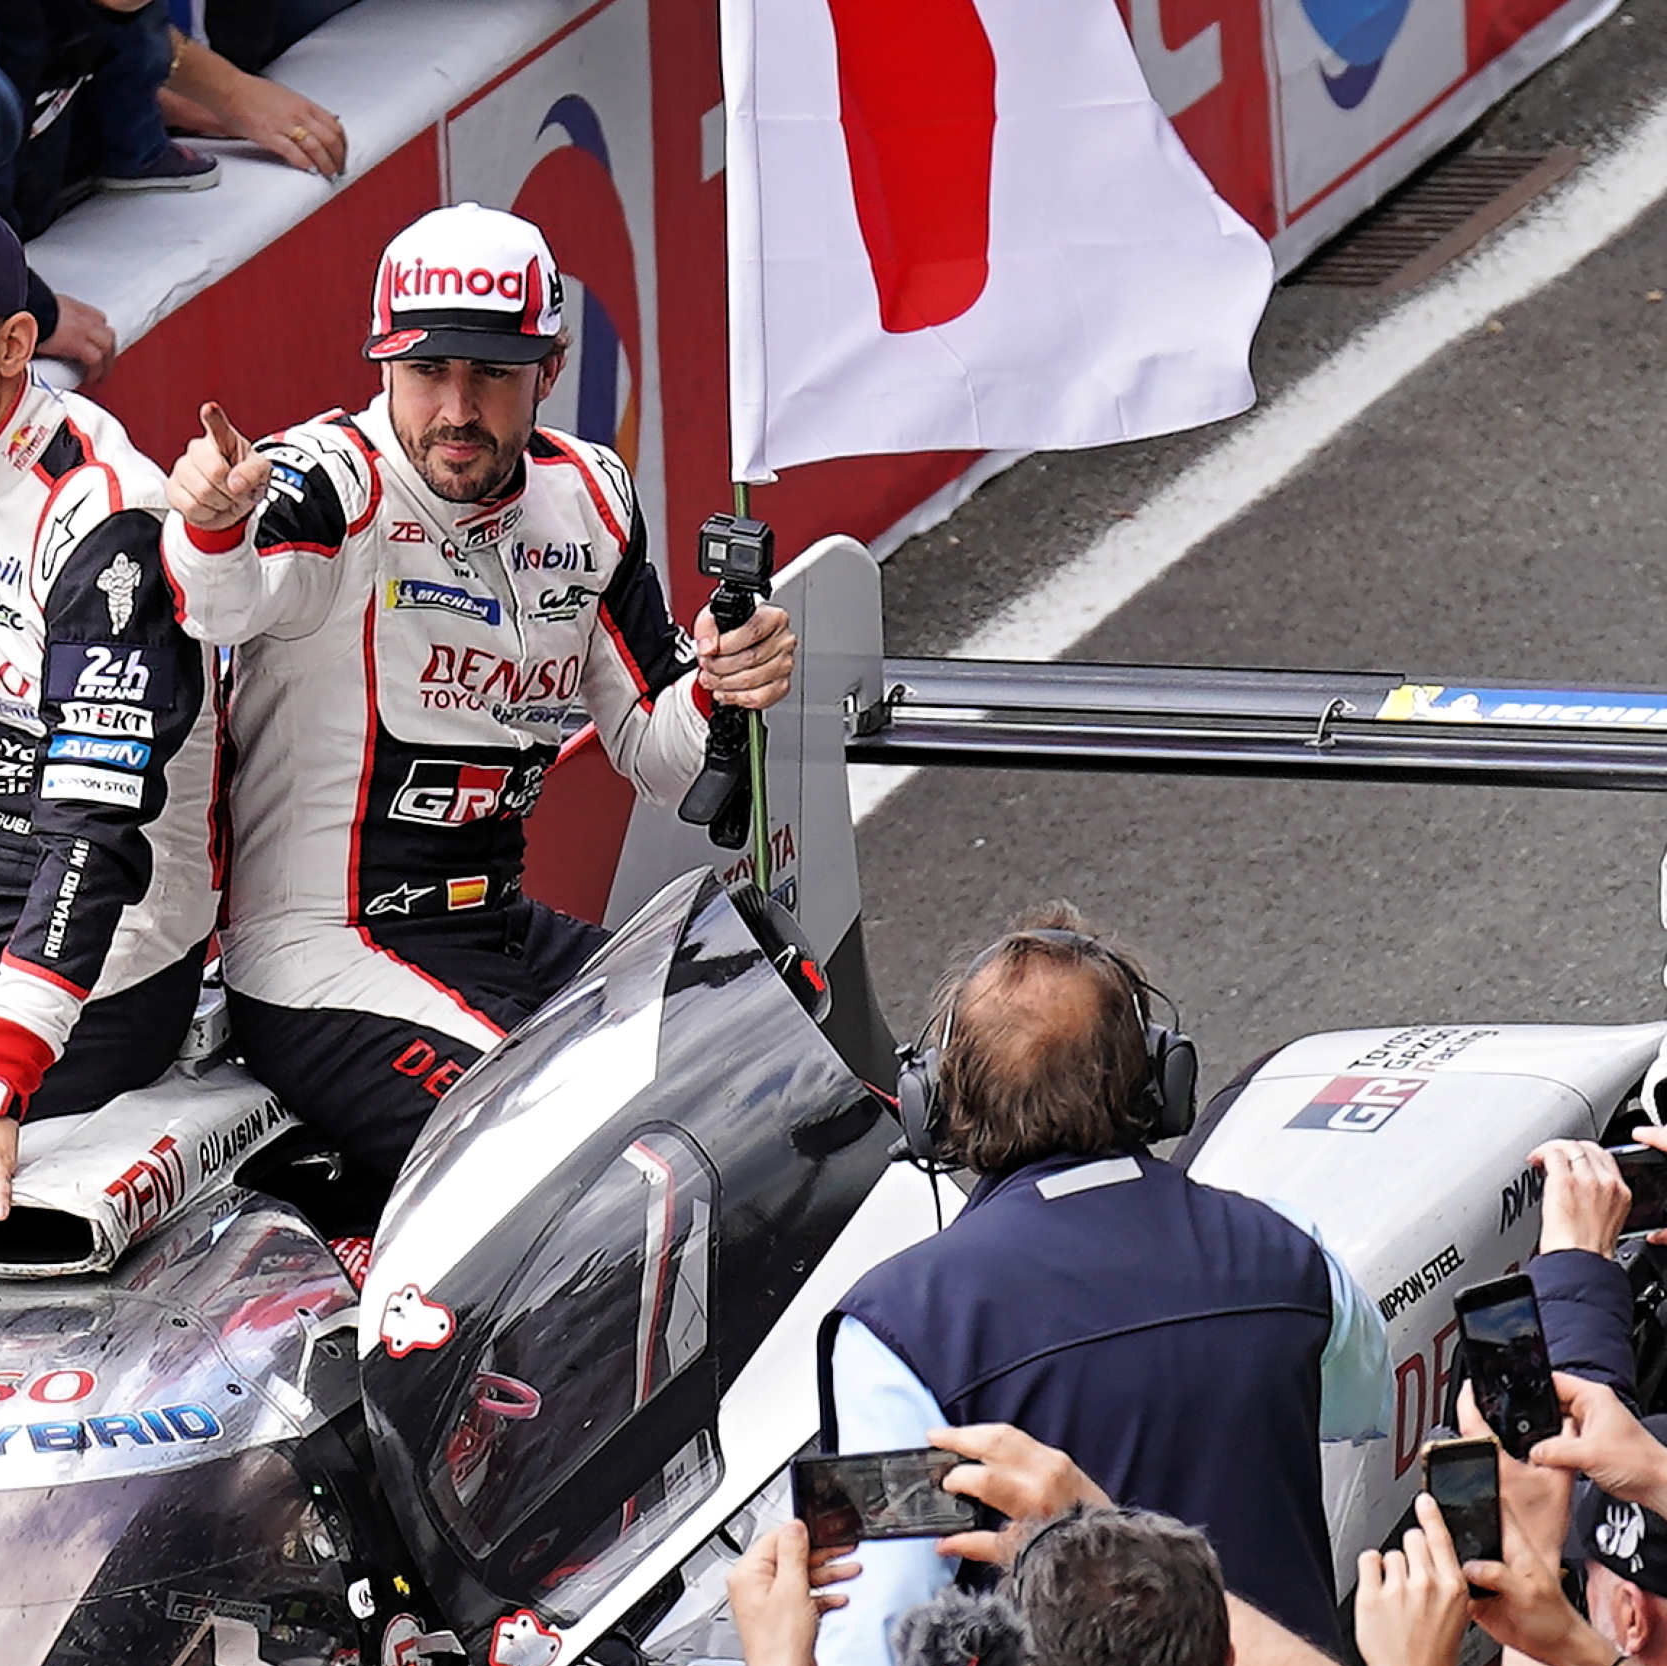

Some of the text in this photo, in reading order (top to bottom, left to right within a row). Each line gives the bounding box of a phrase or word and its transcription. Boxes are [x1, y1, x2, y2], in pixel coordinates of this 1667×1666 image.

[393, 257, 523, 300] kimoa
[58, 739, 144, 767] AISIN
[43, 870, 81, 958] RICHARD
[1420, 1243, 1465, 1292] STEEL
